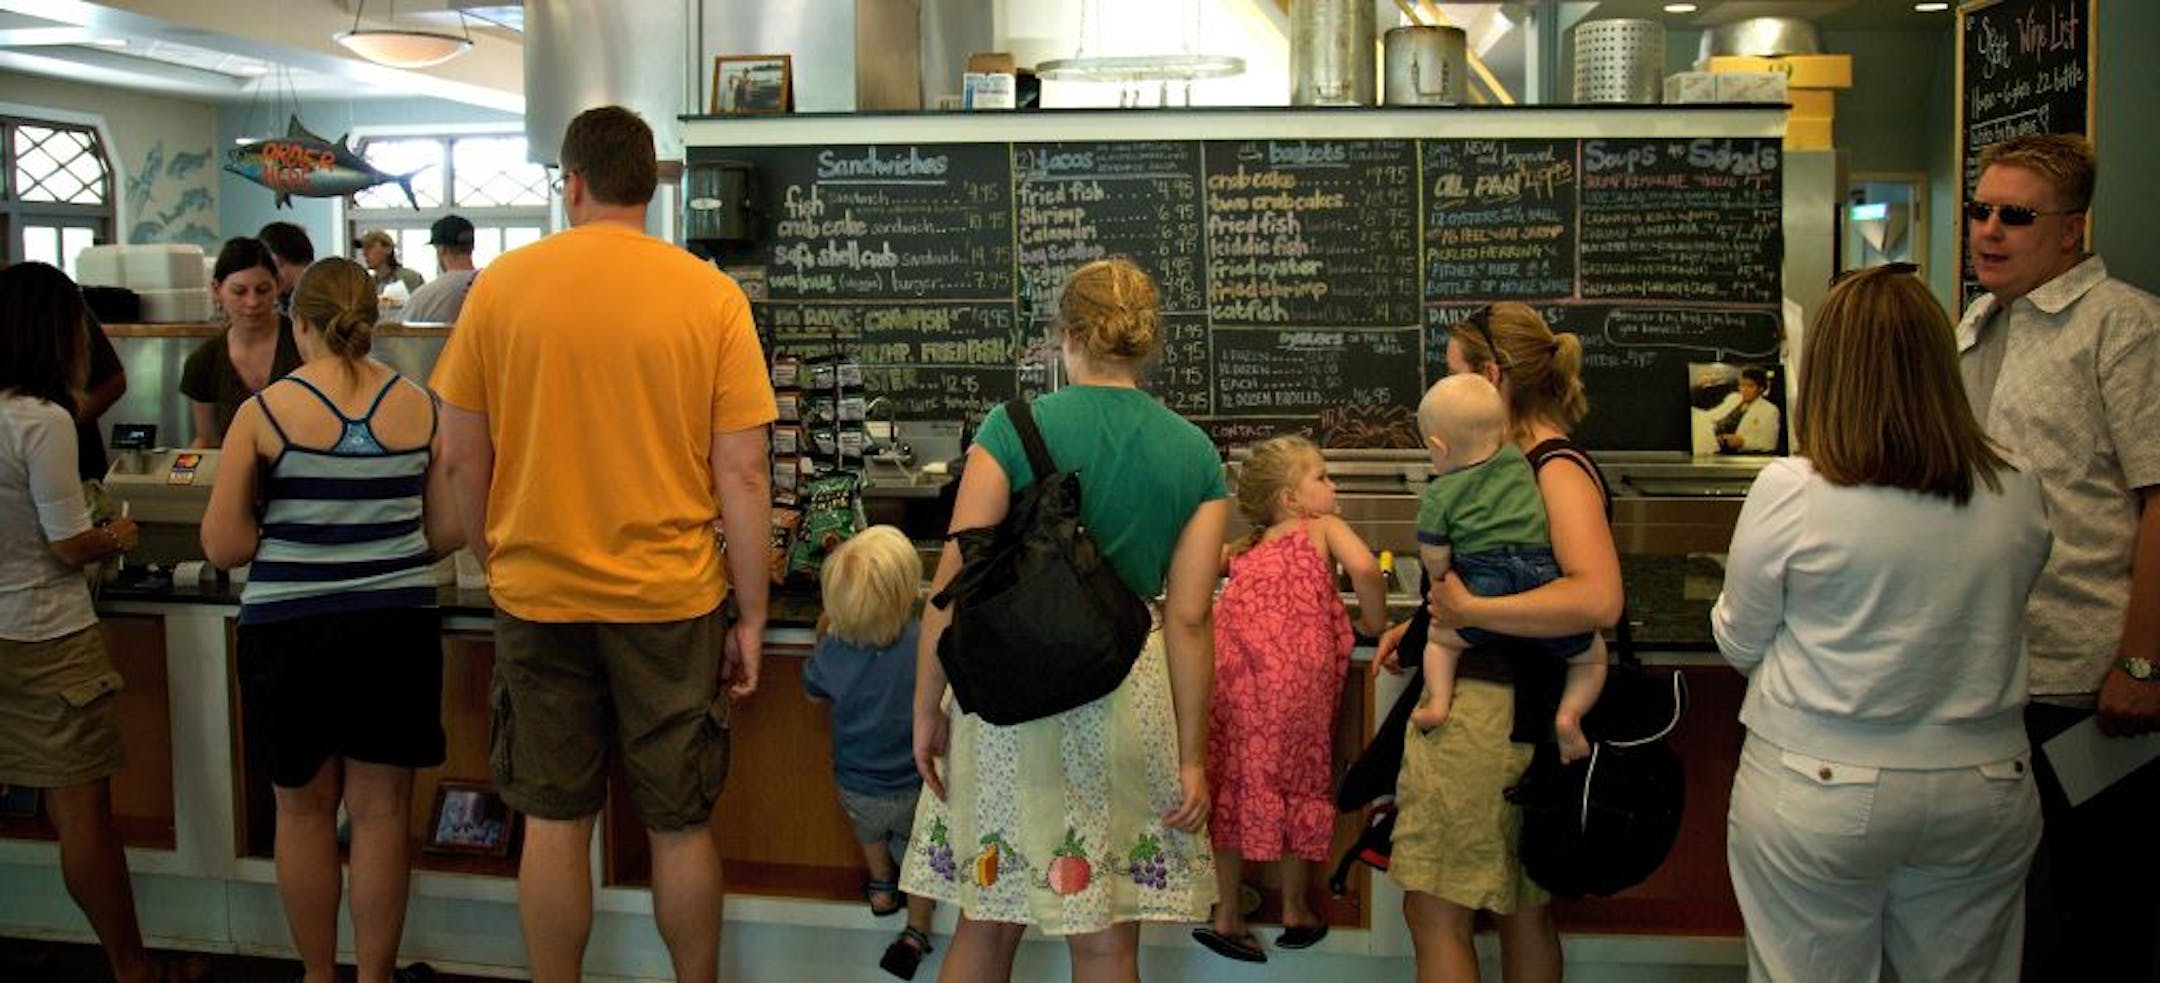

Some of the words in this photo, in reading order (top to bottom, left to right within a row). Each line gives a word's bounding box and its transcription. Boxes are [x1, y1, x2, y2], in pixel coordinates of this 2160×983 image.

[264, 142, 336, 171] ORDER
[817, 146, 949, 178] Sandwiches
[1583, 140, 1658, 174] Soups
[1688, 138, 1778, 176] Salads
[262, 166, 313, 192] HERE
[1207, 164, 1251, 191] crab
[784, 184, 825, 219] fish
[1251, 190, 1295, 211] crab
[777, 215, 820, 239] crab
[822, 207, 868, 237] cake
[1207, 212, 1258, 237] fried
[1258, 210, 1302, 236] fish
[775, 242, 816, 272] soft
[817, 239, 860, 271] shell
[1272, 234, 1310, 258] fish
[1208, 256, 1257, 281] fried
[891, 269, 942, 297] burger
[1211, 297, 1291, 323] catfish
